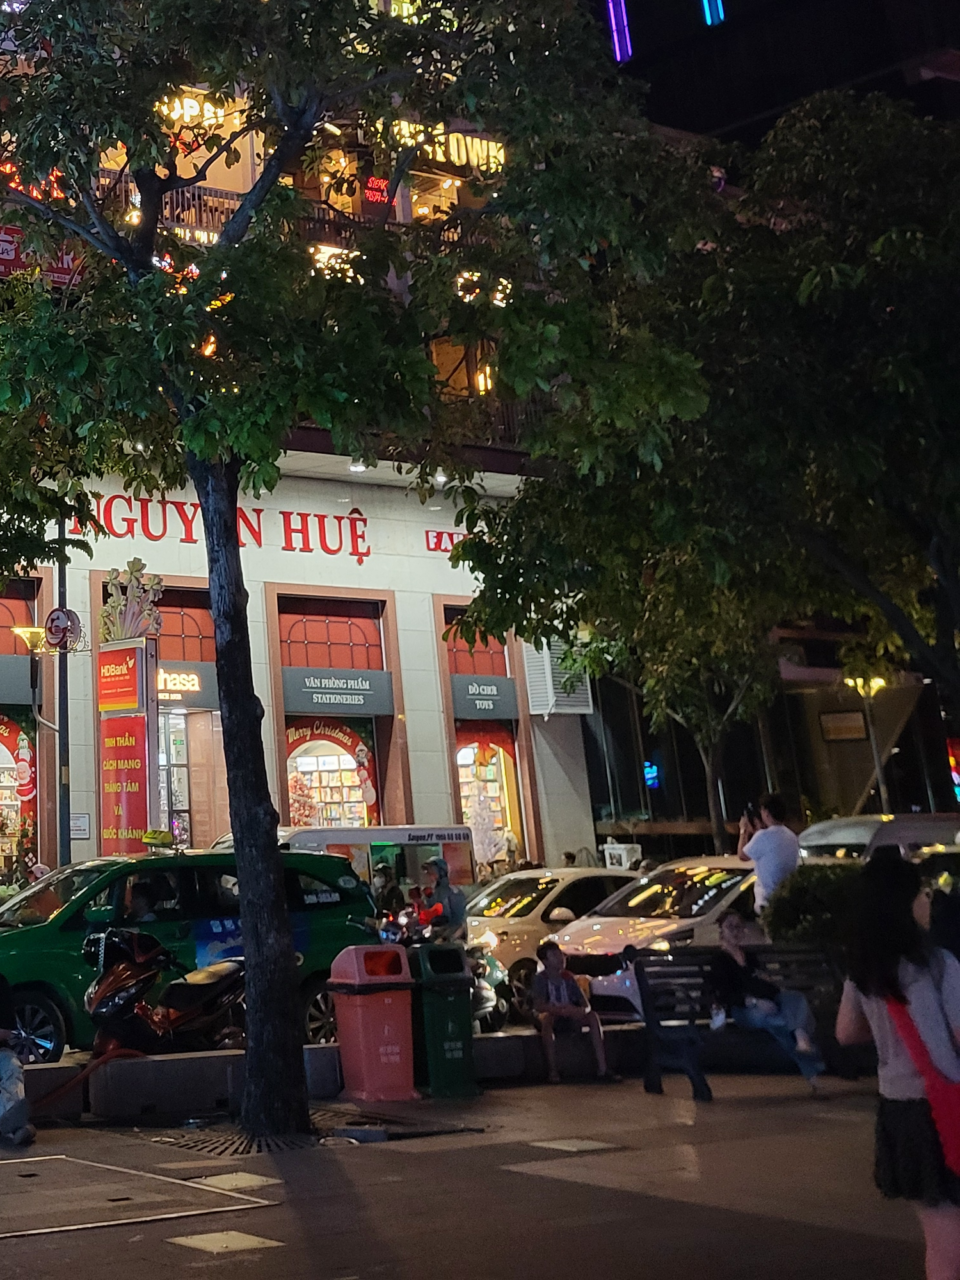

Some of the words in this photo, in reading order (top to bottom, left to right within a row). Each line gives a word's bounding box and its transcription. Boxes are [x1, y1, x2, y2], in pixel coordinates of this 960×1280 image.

[68, 494, 264, 548] NGUYN
[279, 507, 371, 565] HUỆ
[101, 663, 128, 677] HDBank
[305, 677, 320, 688] VĂN
[321, 677, 346, 689] PHÒNG
[313, 694, 364, 704] STATIONERIES
[287, 726, 312, 744] Merry
[313, 721, 352, 746] Christmas
[117, 758, 141, 772] MẠNG
